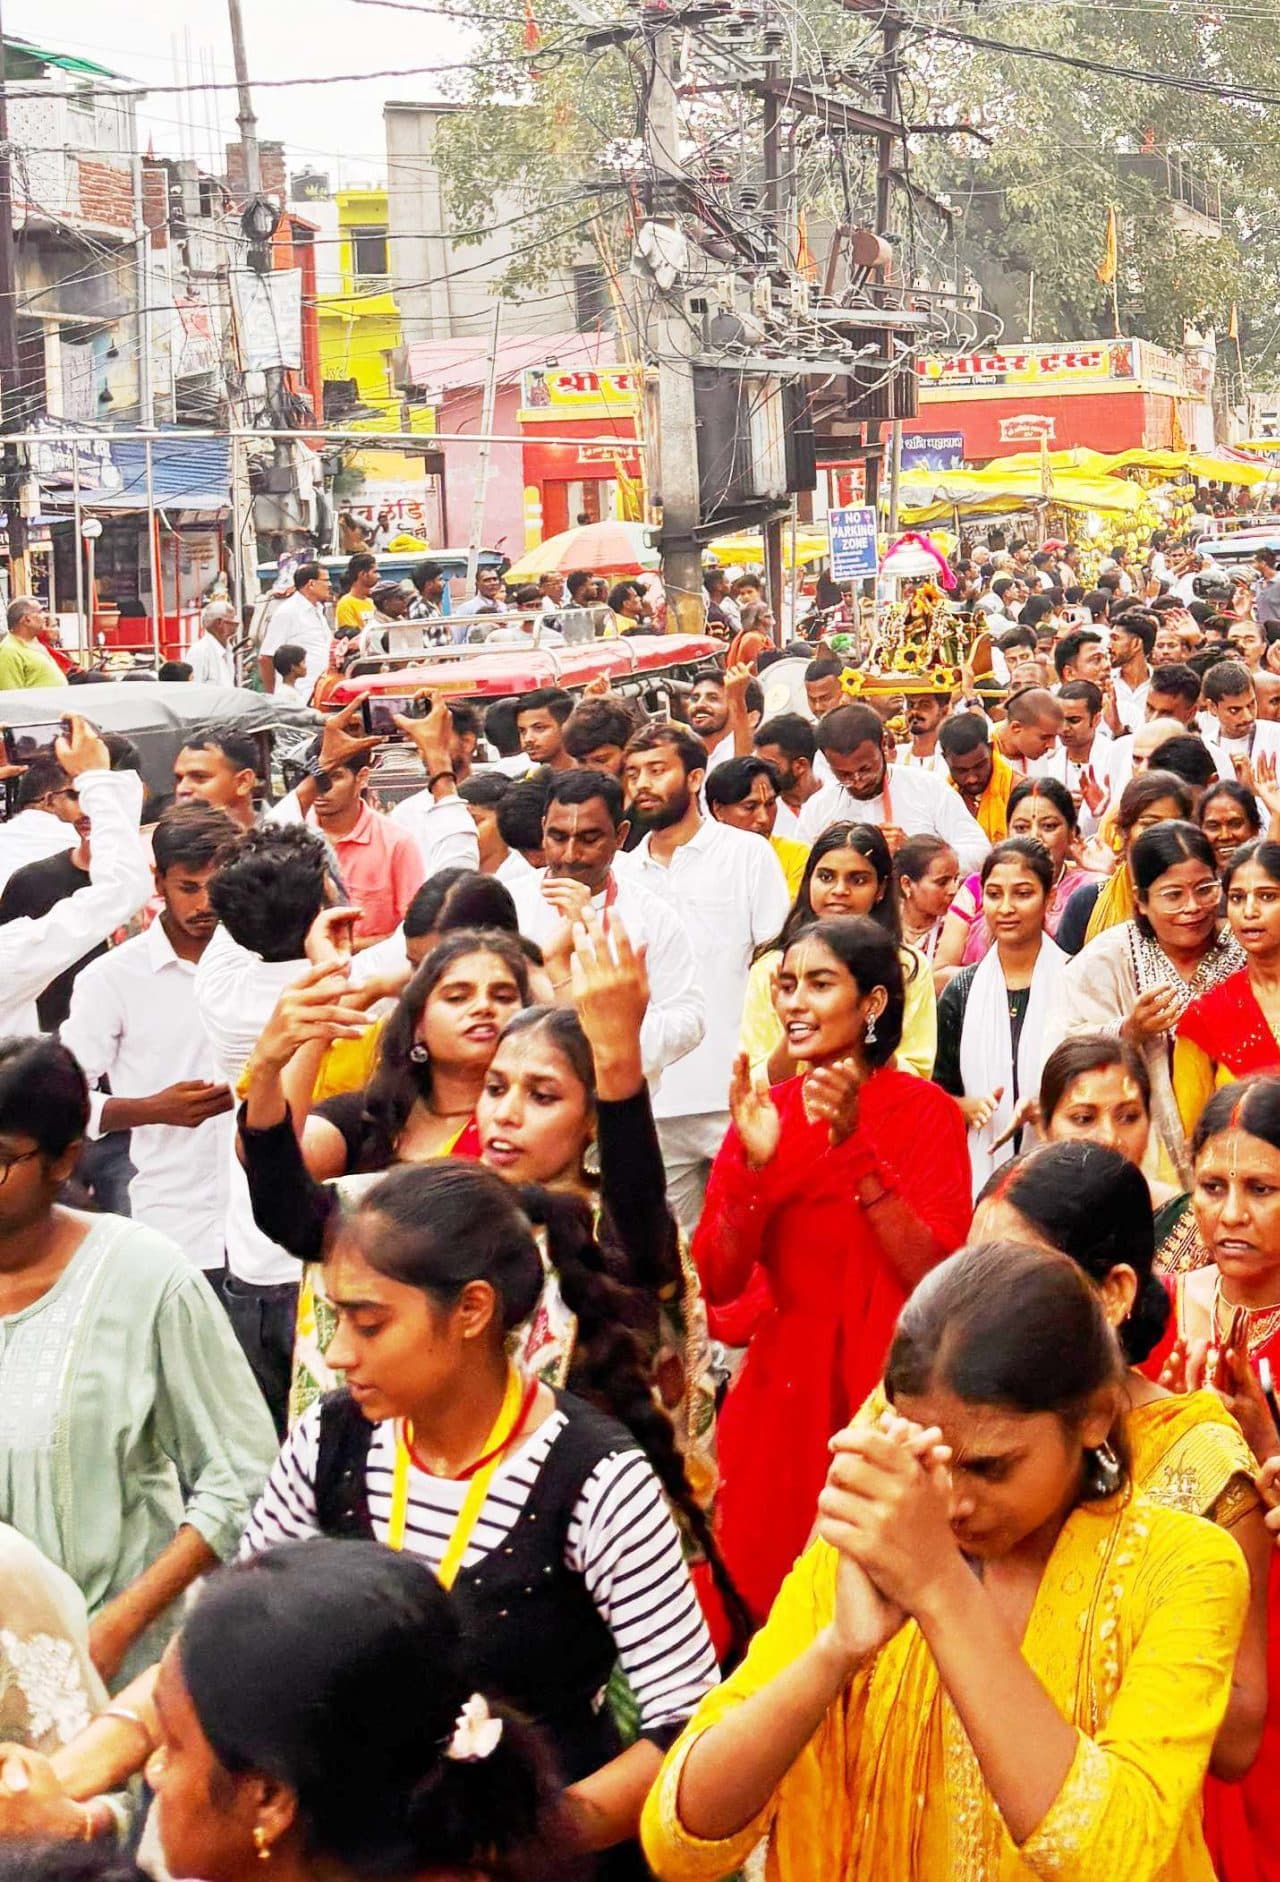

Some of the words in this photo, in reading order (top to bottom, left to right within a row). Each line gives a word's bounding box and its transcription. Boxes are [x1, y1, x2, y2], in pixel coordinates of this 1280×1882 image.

[557, 371, 604, 392] श्री
[845, 512, 861, 524] NO
[831, 525, 875, 539] PARKING
[842, 537, 869, 550] ZONE
